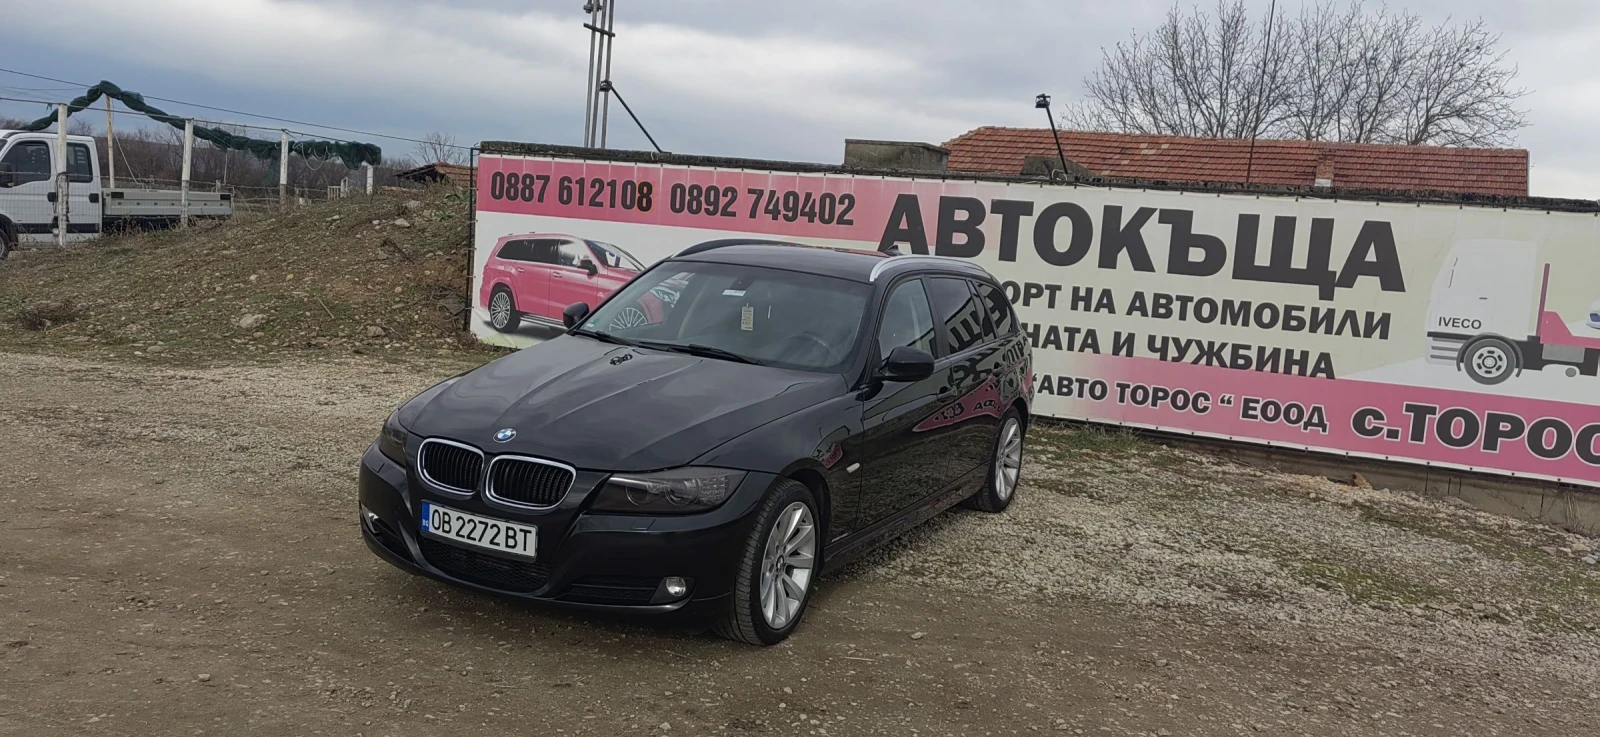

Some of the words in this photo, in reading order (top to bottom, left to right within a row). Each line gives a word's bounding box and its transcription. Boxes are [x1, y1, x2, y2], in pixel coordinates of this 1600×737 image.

[490, 171, 551, 203] 0887
[558, 176, 654, 212] 612108
[669, 183, 738, 217] 0892
[747, 188, 856, 226] 749402
[877, 193, 1406, 301] АВТОКЪЩА
[1070, 286, 1116, 314] НА
[1126, 291, 1391, 340] АВТОМОБИЛИ
[1438, 316, 1482, 330] IVECO
[1111, 331, 1136, 358] И
[1147, 334, 1336, 379] ЧУЖБИНА
[1115, 382, 1211, 414] ТОРОС
[1241, 397, 1329, 433] ЕООД
[432, 509, 452, 534] OB
[455, 516, 501, 546] 2272
[505, 526, 532, 551] BT
